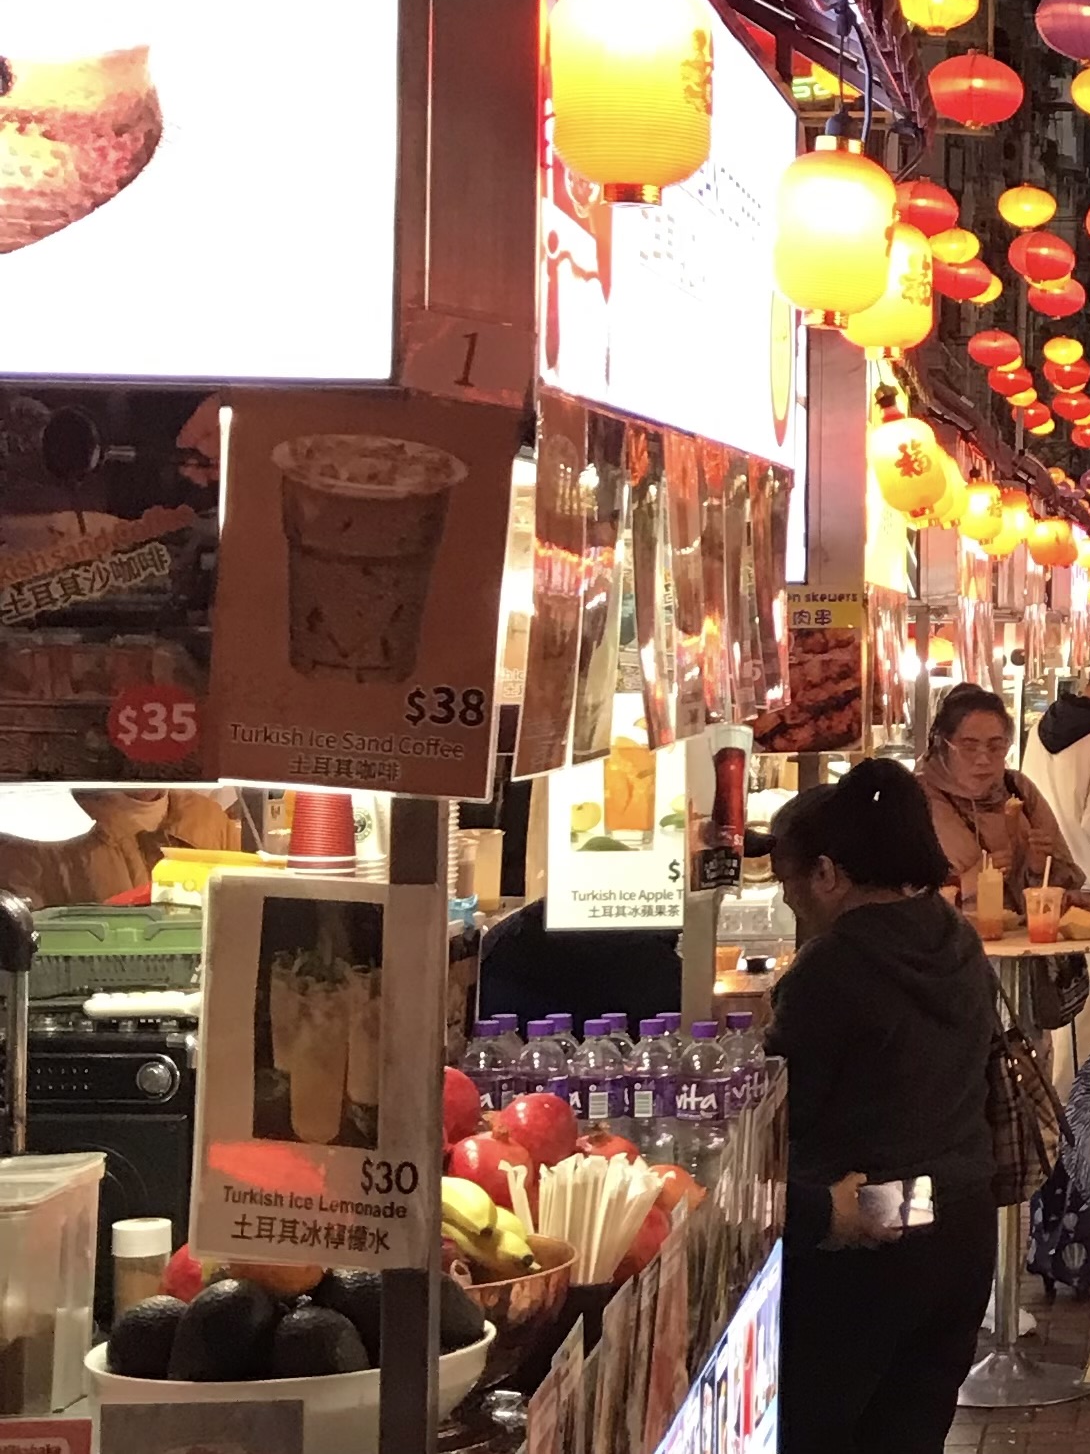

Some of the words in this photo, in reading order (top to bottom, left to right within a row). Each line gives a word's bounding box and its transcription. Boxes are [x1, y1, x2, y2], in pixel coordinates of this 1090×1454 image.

[117, 702, 197, 745] $35
[405, 687, 484, 726] $38
[231, 724, 303, 746] Turkish
[309, 730, 337, 749] Ice
[342, 733, 393, 753] Sand
[399, 737, 464, 758] Coffee
[289, 757, 400, 781] 土耳其咖啡
[571, 889, 617, 902] Turkish
[619, 890, 636, 902] Ice
[638, 889, 674, 903] Apple
[675, 1083, 718, 1111] vita
[361, 1157, 419, 1196] $30
[223, 1185, 284, 1208] Turkish
[319, 1194, 408, 1219] Lemonade
[231, 1213, 391, 1255] 土耳其冰檸檬水
